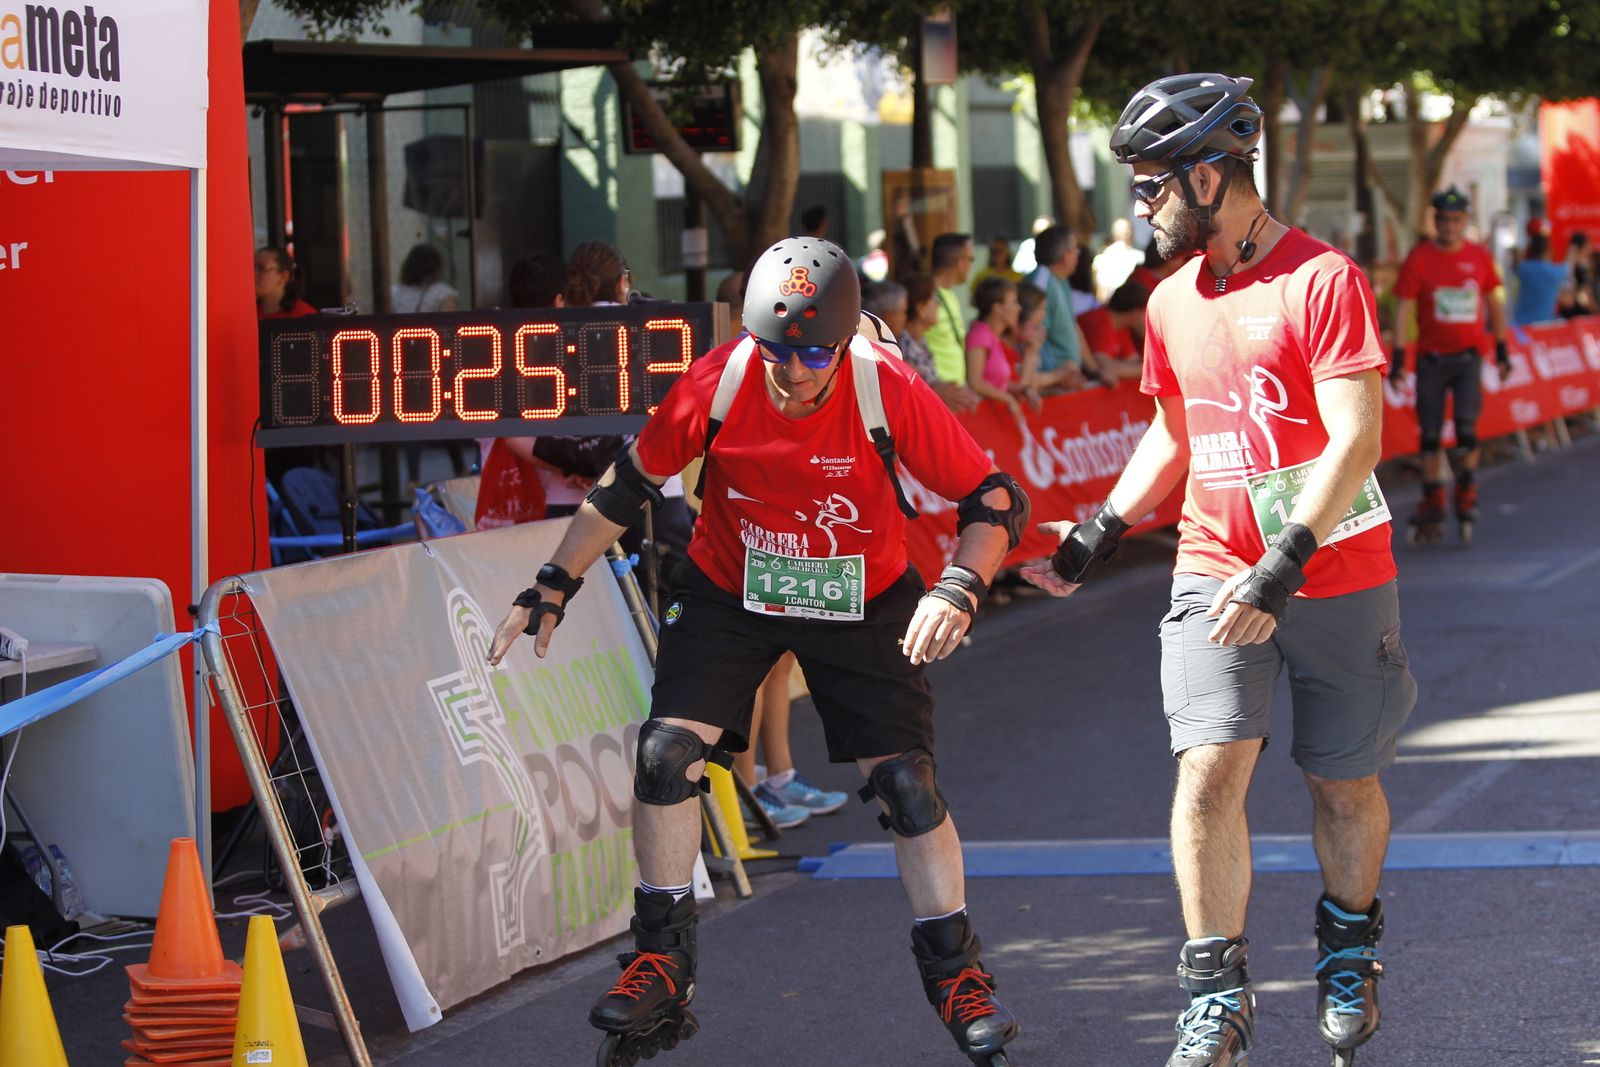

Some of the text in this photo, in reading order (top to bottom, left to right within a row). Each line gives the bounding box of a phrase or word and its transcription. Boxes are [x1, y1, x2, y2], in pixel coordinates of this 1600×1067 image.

[39, 82, 121, 118] deportivo
[1190, 430, 1251, 454] CARRERA
[740, 518, 810, 549] CARRERA
[787, 560, 829, 569] CARRERA
[757, 572, 843, 600] 1216
[784, 596, 826, 608] J.CANTON
